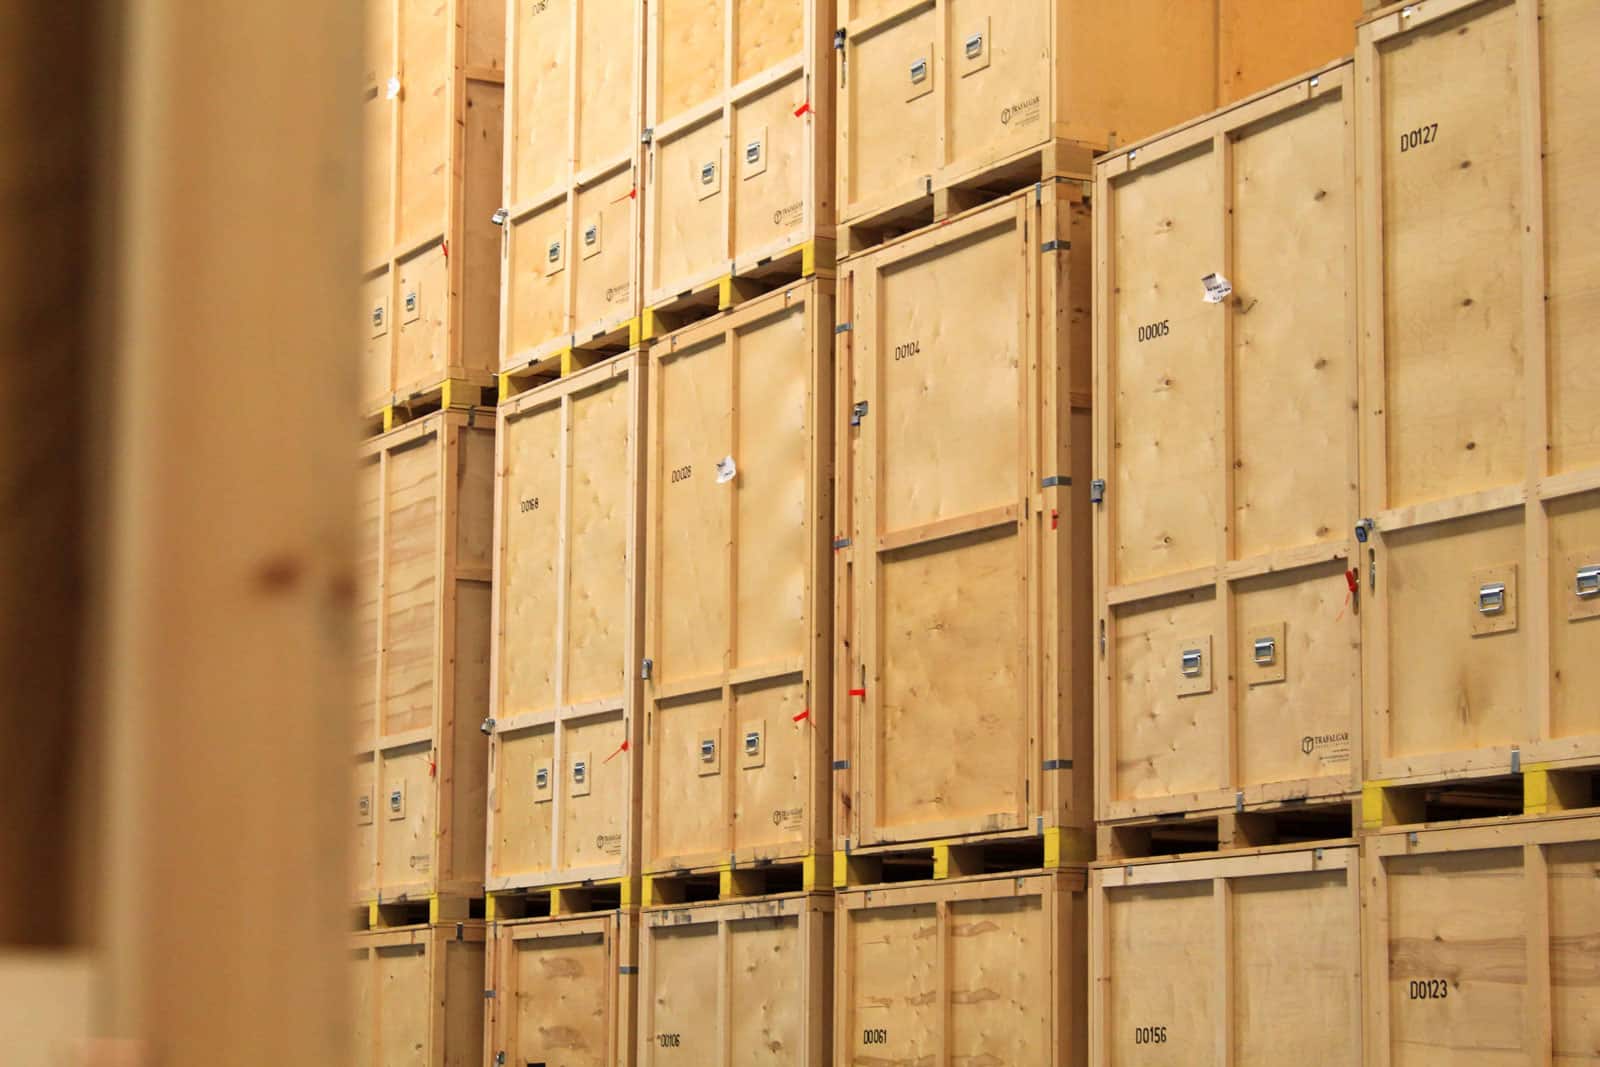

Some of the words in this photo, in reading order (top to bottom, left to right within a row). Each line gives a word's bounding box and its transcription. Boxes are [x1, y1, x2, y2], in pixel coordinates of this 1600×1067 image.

[1400, 123, 1439, 153] D0127
[1138, 319, 1169, 343] D0005
[895, 340, 921, 361] D0104
[1315, 732, 1349, 745] TRAFALGAR
[1409, 979, 1448, 1000] D0123
[1135, 1026, 1167, 1045] D0156
